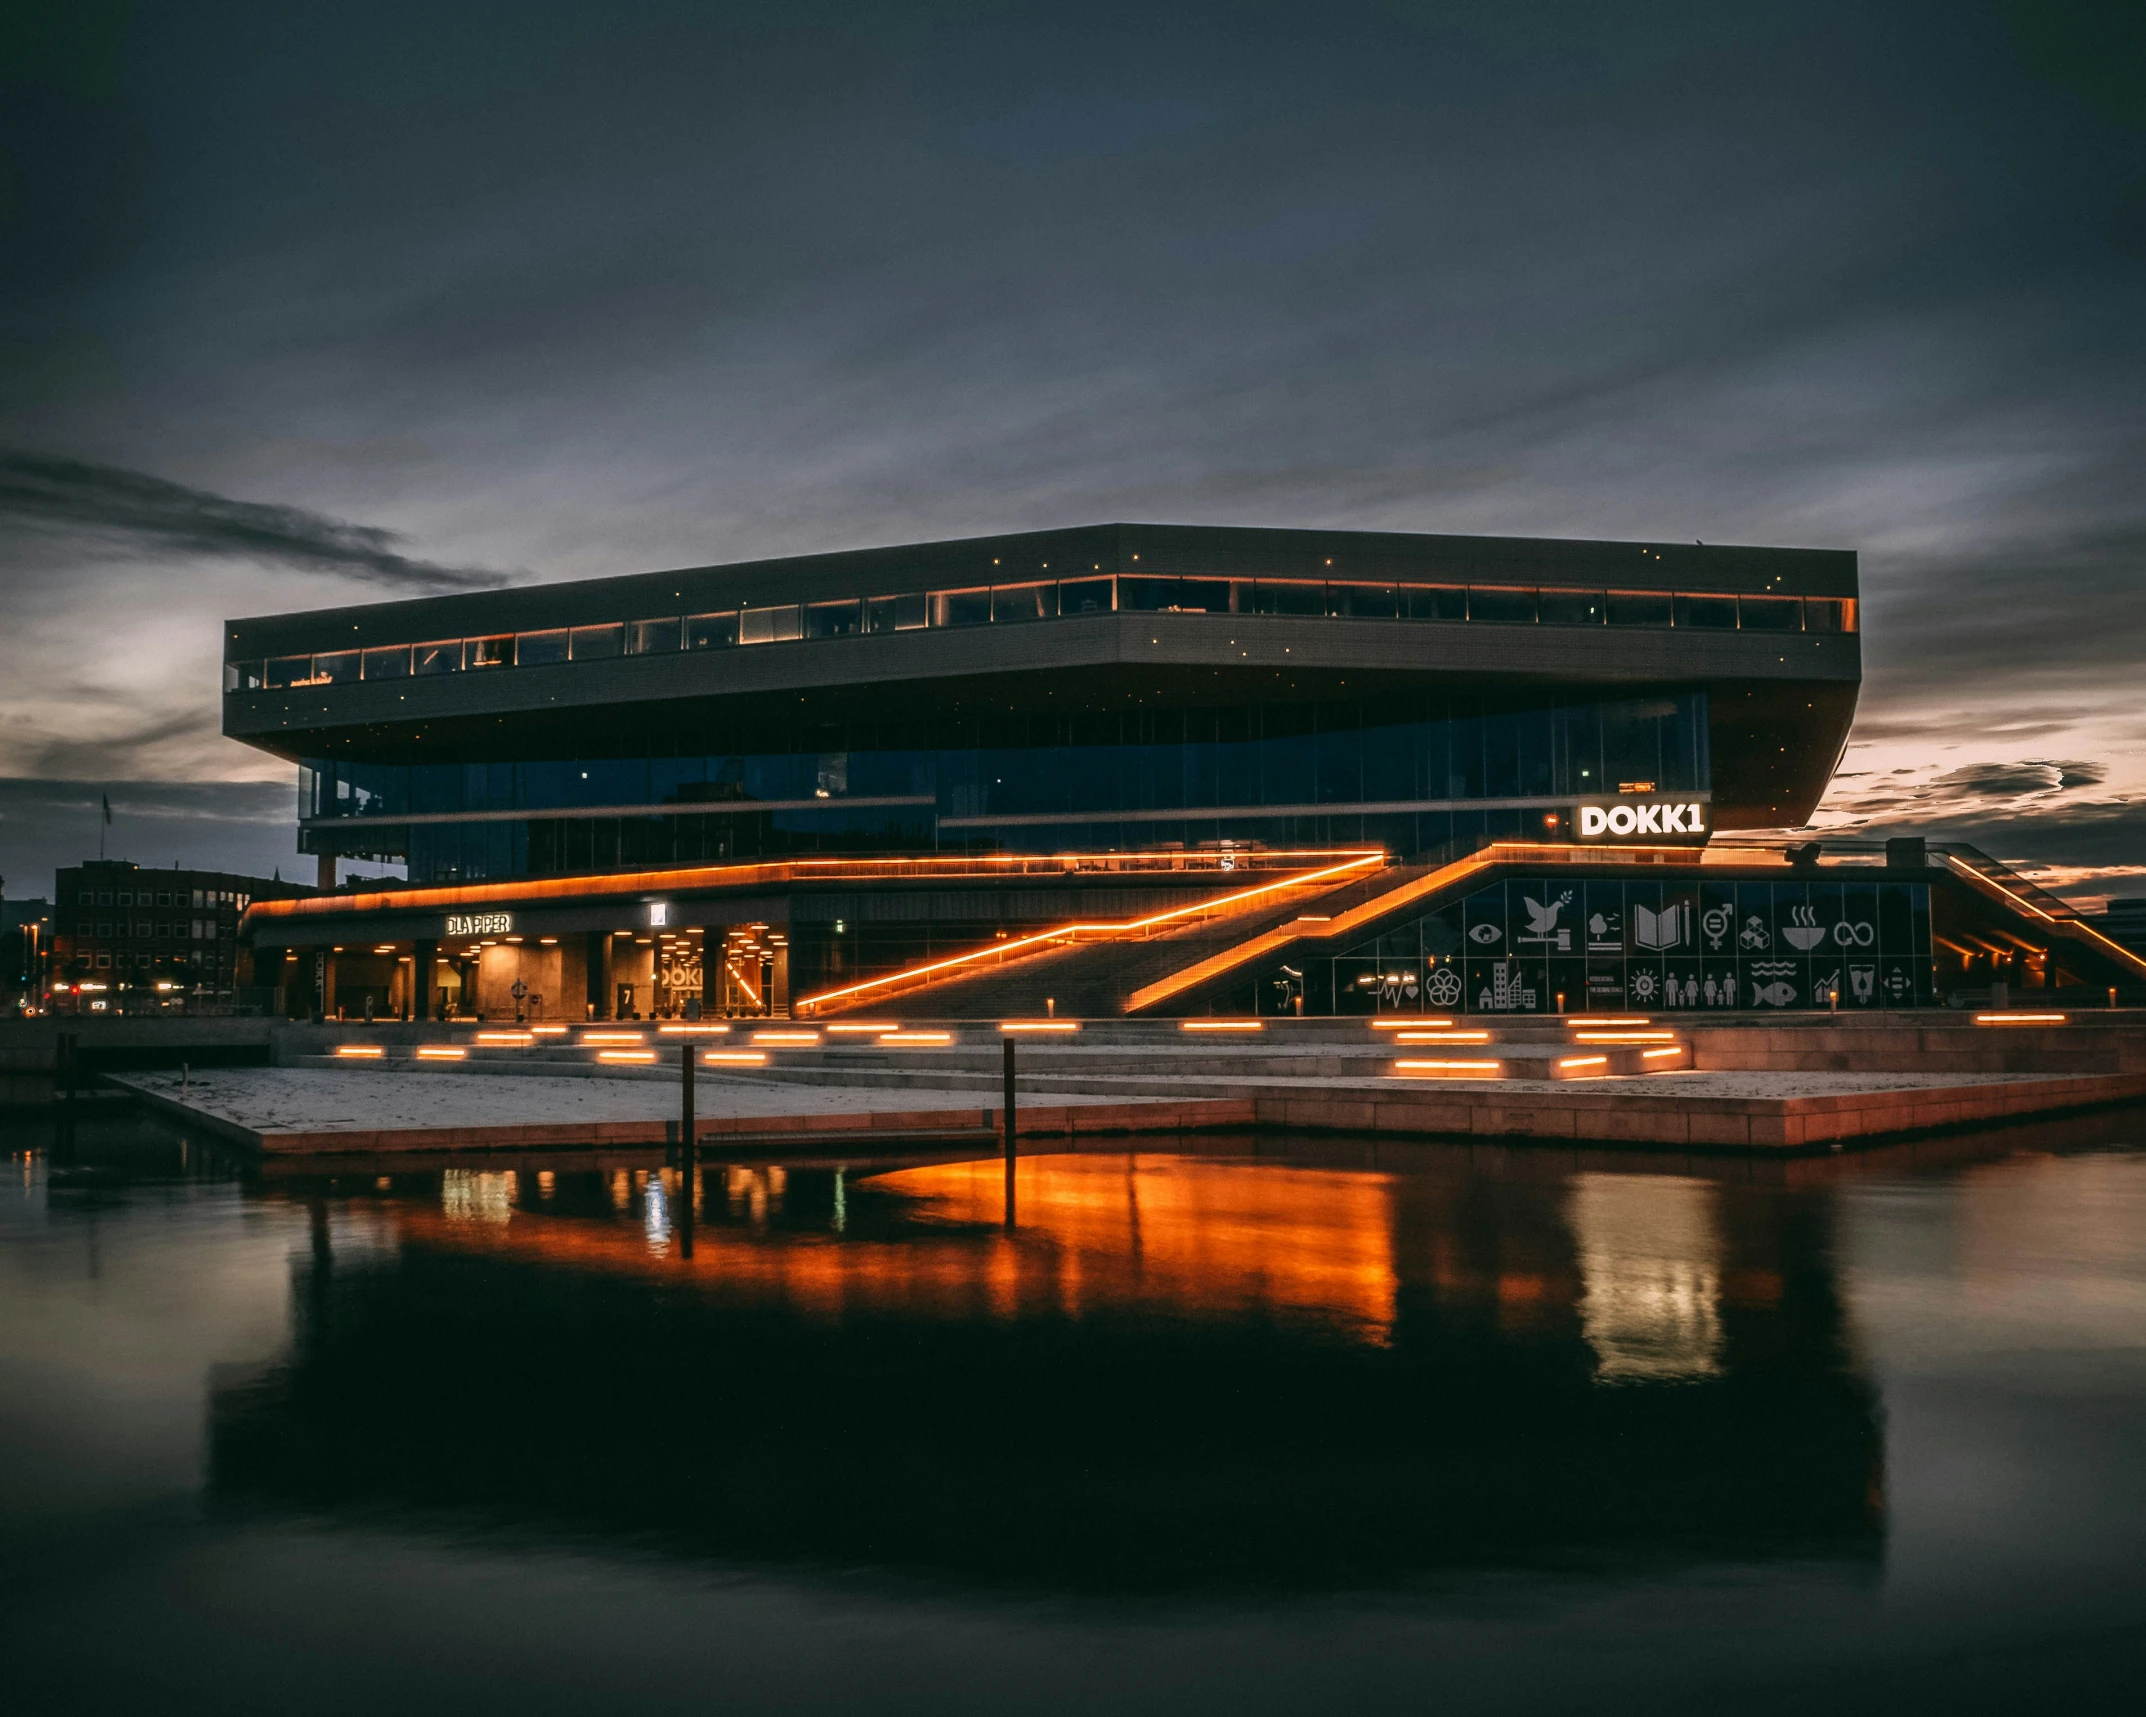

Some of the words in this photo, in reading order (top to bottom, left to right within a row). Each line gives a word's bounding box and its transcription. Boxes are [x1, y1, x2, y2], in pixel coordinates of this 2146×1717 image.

[1581, 804, 1704, 835] DOKK1
[448, 917, 473, 936] DLA
[624, 989, 631, 1004] 7
